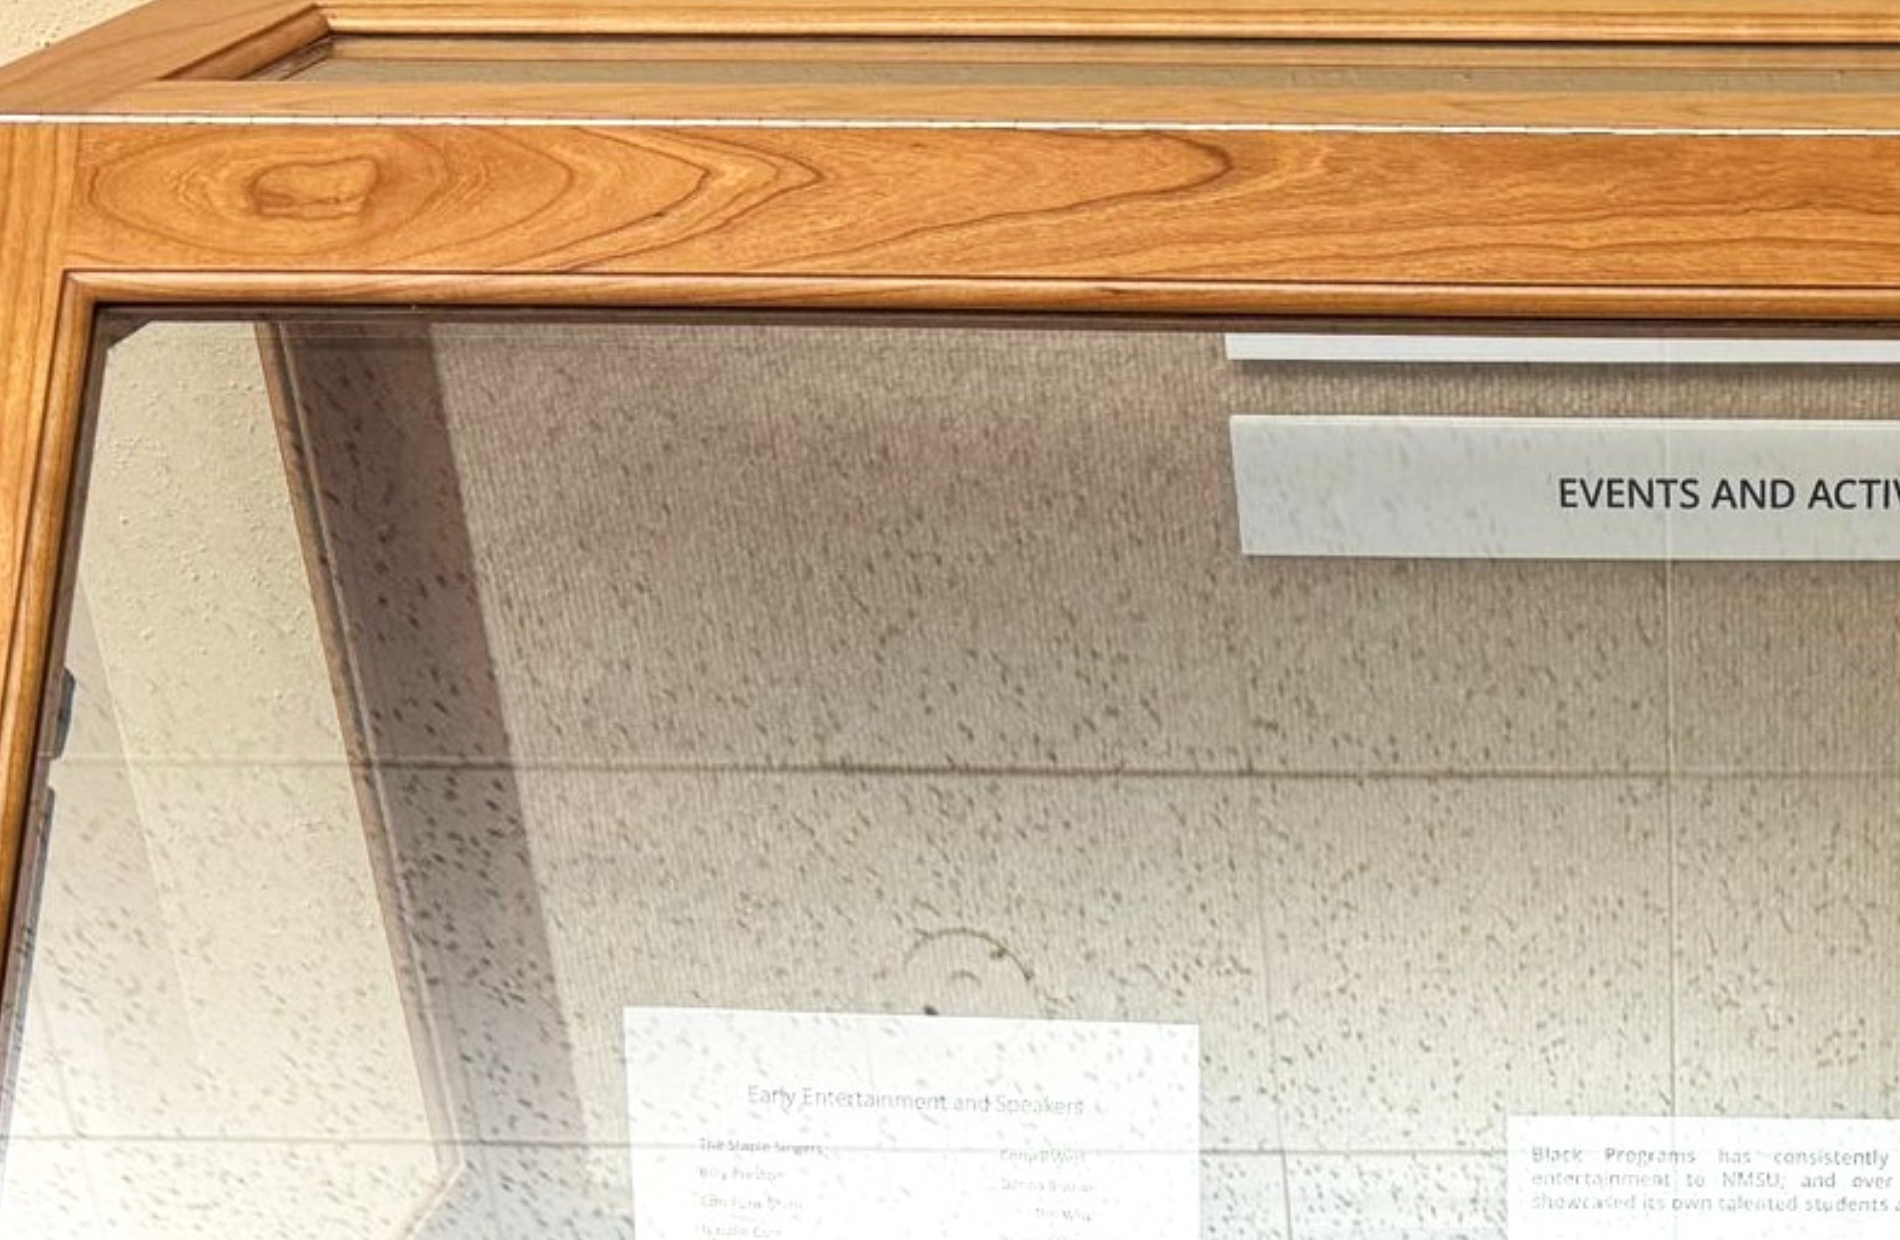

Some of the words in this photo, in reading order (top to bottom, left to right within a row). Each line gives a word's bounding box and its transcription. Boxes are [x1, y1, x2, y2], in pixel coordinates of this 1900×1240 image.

[1559, 477, 1699, 509] EVENTS
[1711, 478, 1795, 509] AND
[748, 1085, 795, 1109] Early
[802, 1087, 945, 1111] Entertainment
[953, 1095, 990, 1112] and
[995, 1094, 1084, 1117] Speakers
[1531, 1147, 1582, 1163] Black
[1604, 1147, 1695, 1167] Programs
[1718, 1149, 1751, 1164] has
[1773, 1149, 1889, 1169] consistently
[1531, 1172, 1671, 1187] entertainment
[1686, 1173, 1705, 1187] to
[1801, 1174, 1836, 1188] and
[1852, 1176, 1893, 1189] over
[1672, 1198, 1712, 1210] own
[1718, 1195, 1798, 1211] talented
[1805, 1197, 1888, 1212] students
